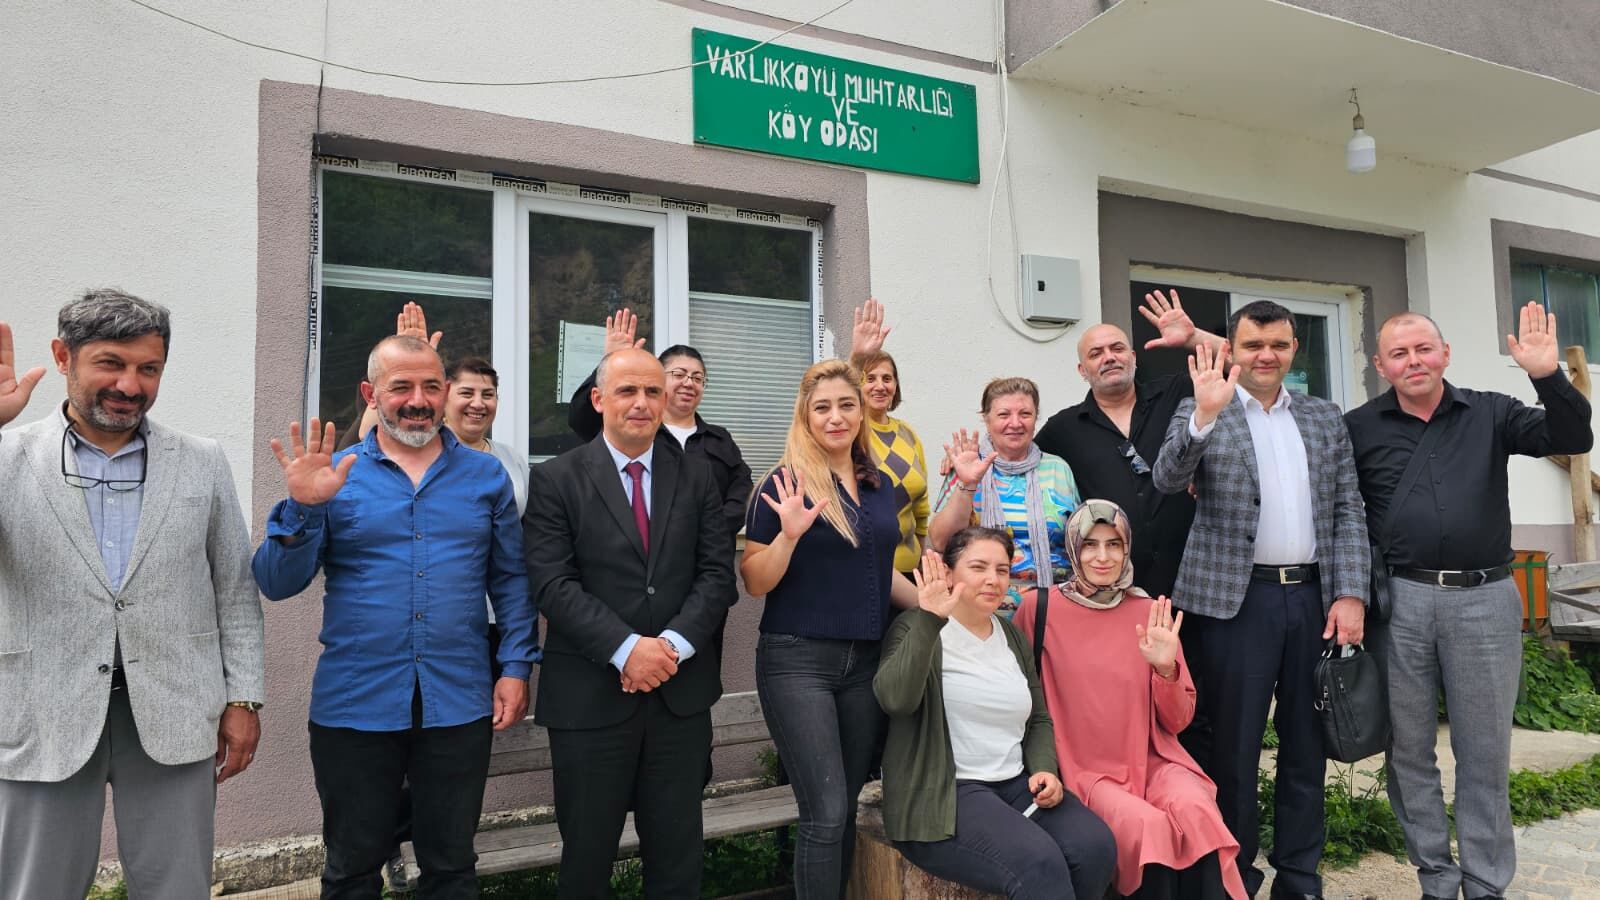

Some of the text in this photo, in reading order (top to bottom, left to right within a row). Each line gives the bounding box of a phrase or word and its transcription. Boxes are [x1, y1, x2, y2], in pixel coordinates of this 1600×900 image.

[831, 96, 859, 126] VE
[844, 73, 954, 118] MUHTARLIĞI
[768, 108, 878, 154] KÖY ODASI
